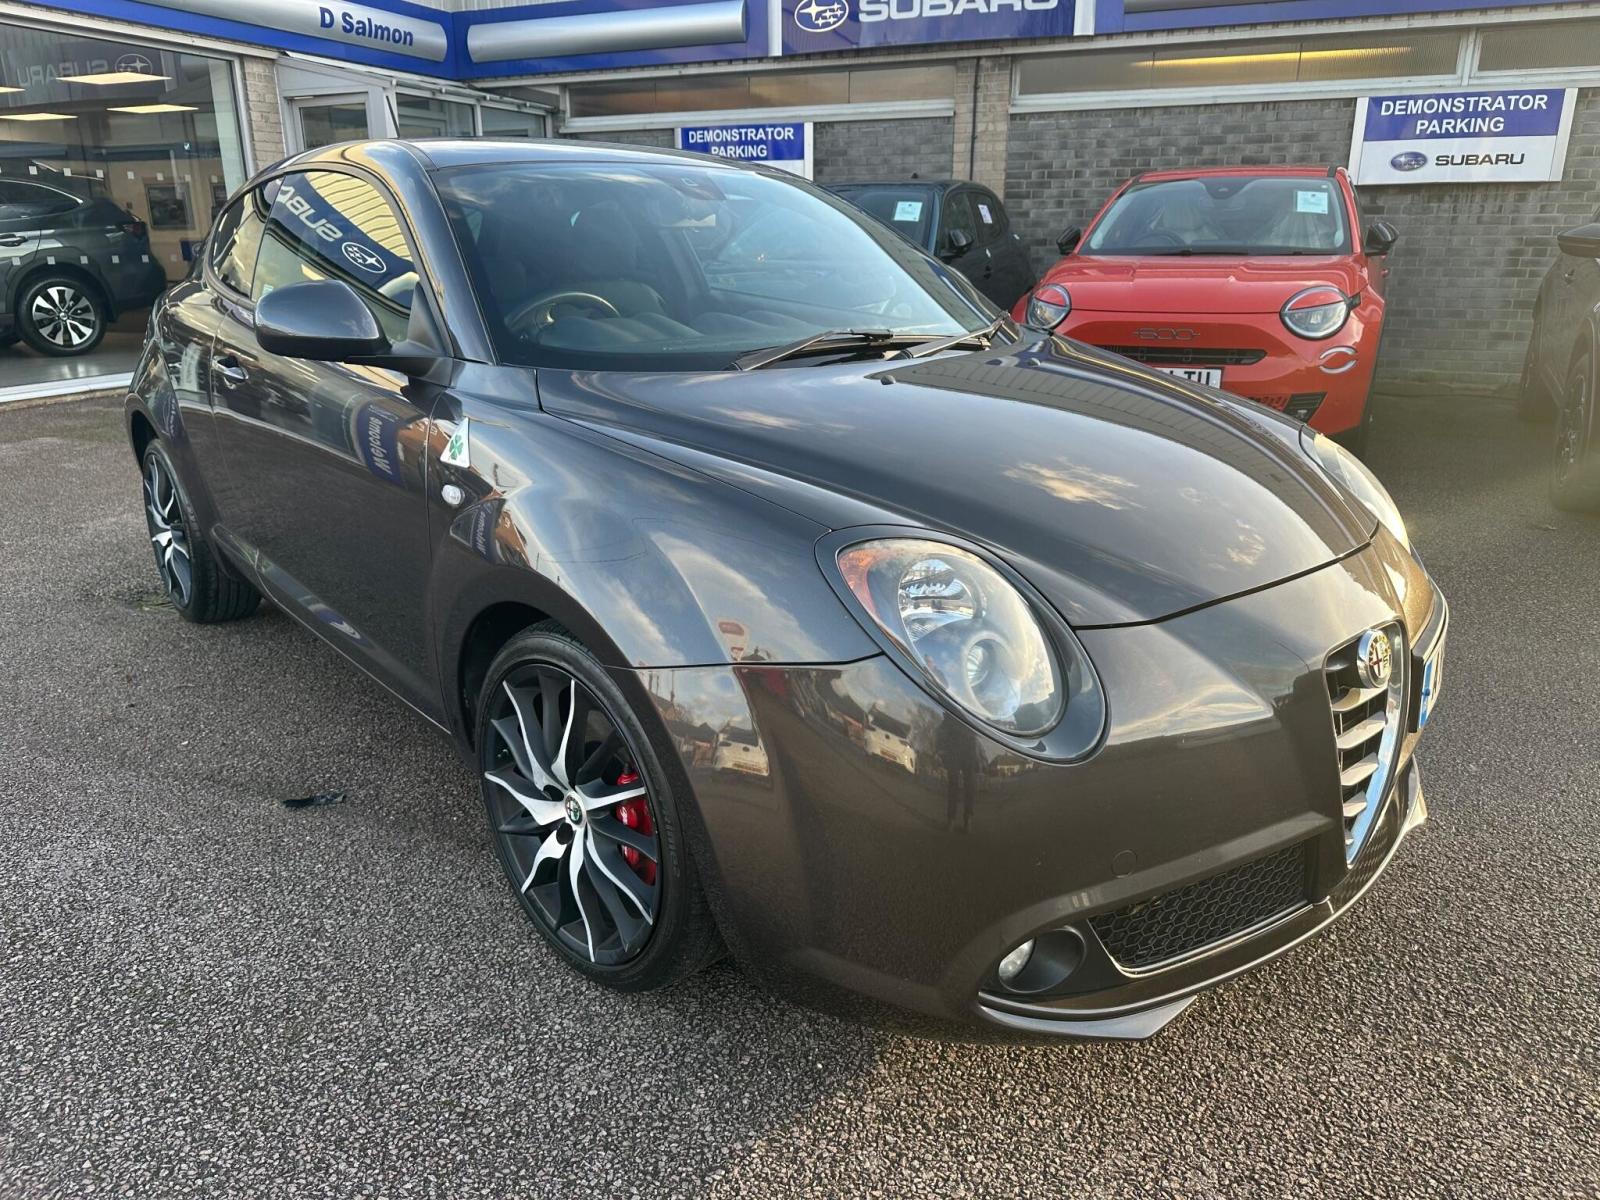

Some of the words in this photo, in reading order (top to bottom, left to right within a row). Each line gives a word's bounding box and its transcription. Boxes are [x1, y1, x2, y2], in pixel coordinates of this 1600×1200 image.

[320, 7, 335, 28] D
[341, 11, 414, 46] Salmon
[1380, 94, 1548, 116] DEMONSTRATOR
[1415, 117, 1505, 135] PARKING
[688, 127, 795, 144] DEMONSTRATOR
[711, 144, 768, 158] PARKING
[1434, 153, 1526, 167] SUBARU
